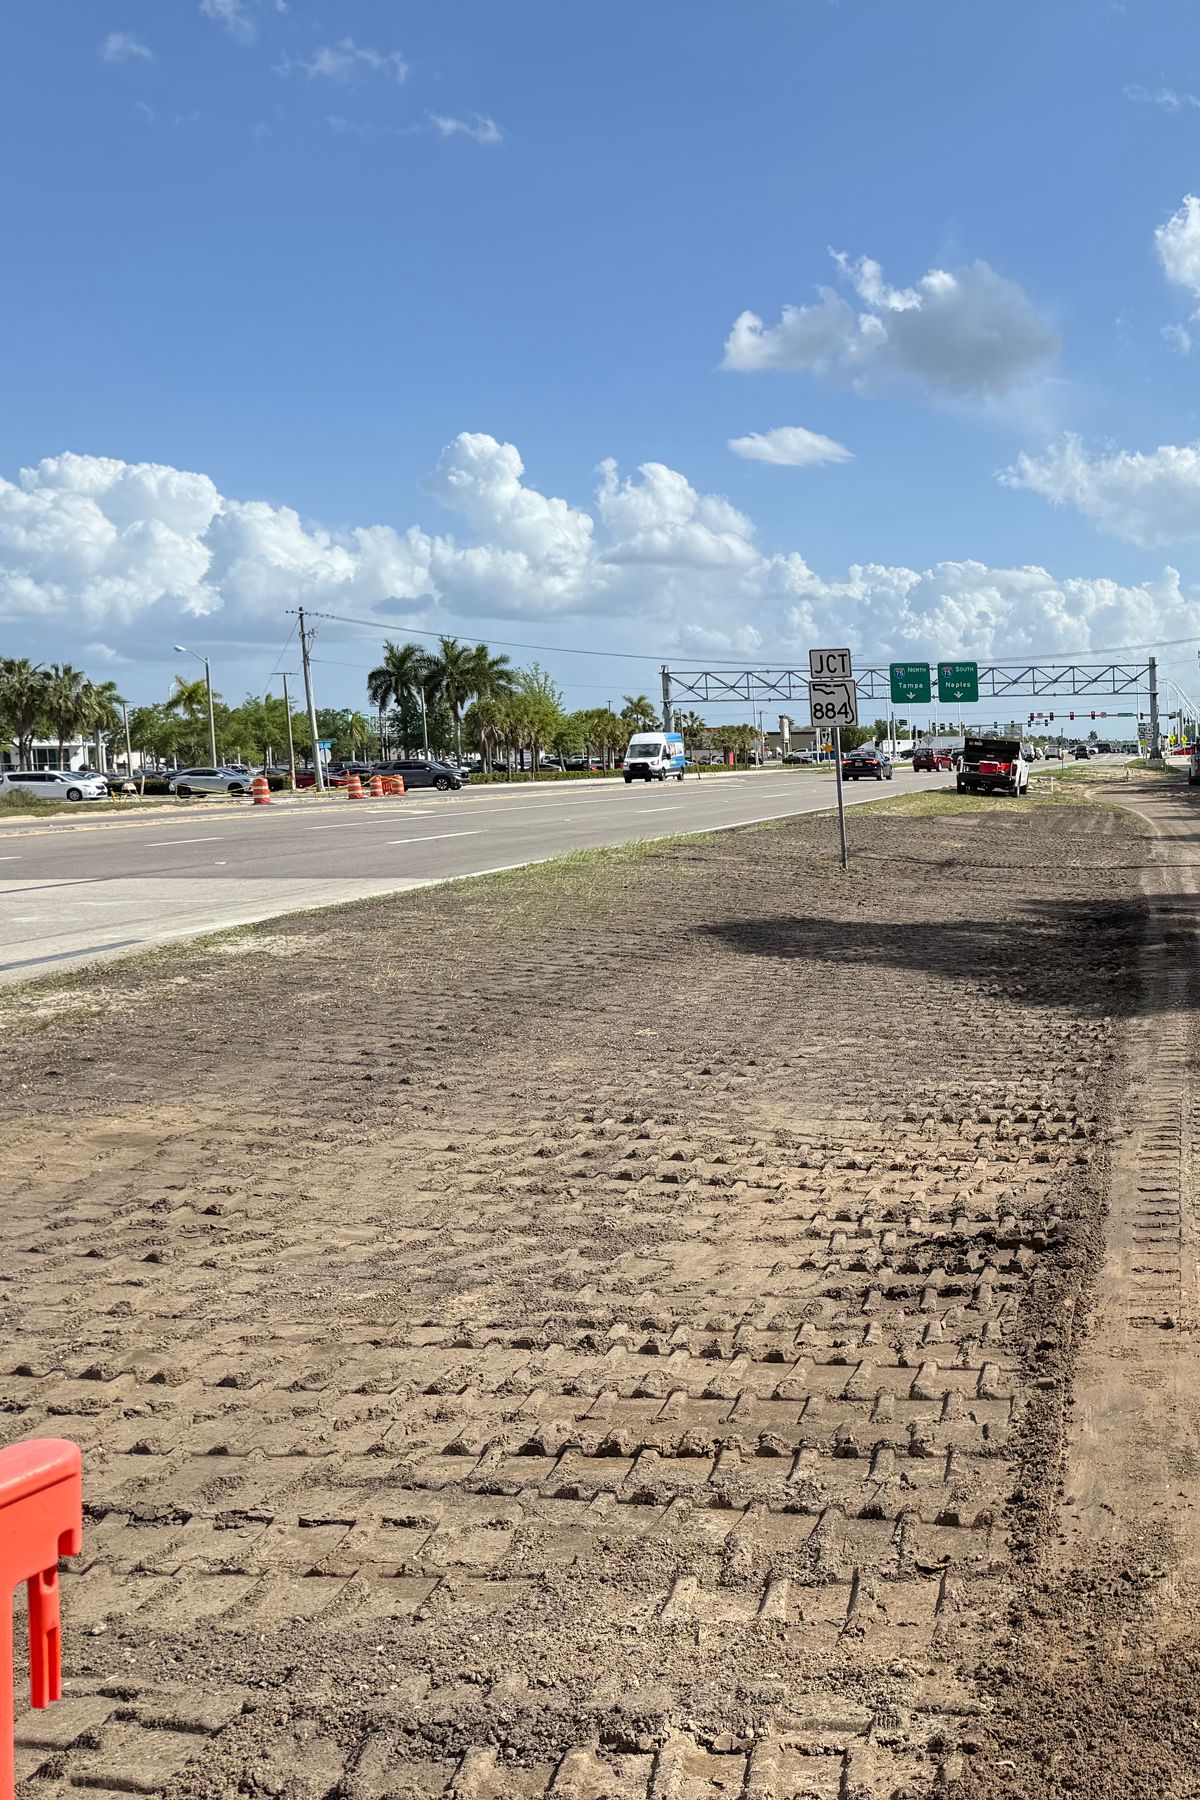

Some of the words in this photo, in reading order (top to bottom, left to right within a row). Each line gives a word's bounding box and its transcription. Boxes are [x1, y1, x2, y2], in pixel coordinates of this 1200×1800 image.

[814, 653, 848, 674] JCT
[898, 682, 924, 690] Tampa
[945, 681, 971, 689] Naples
[813, 701, 850, 719] 884
